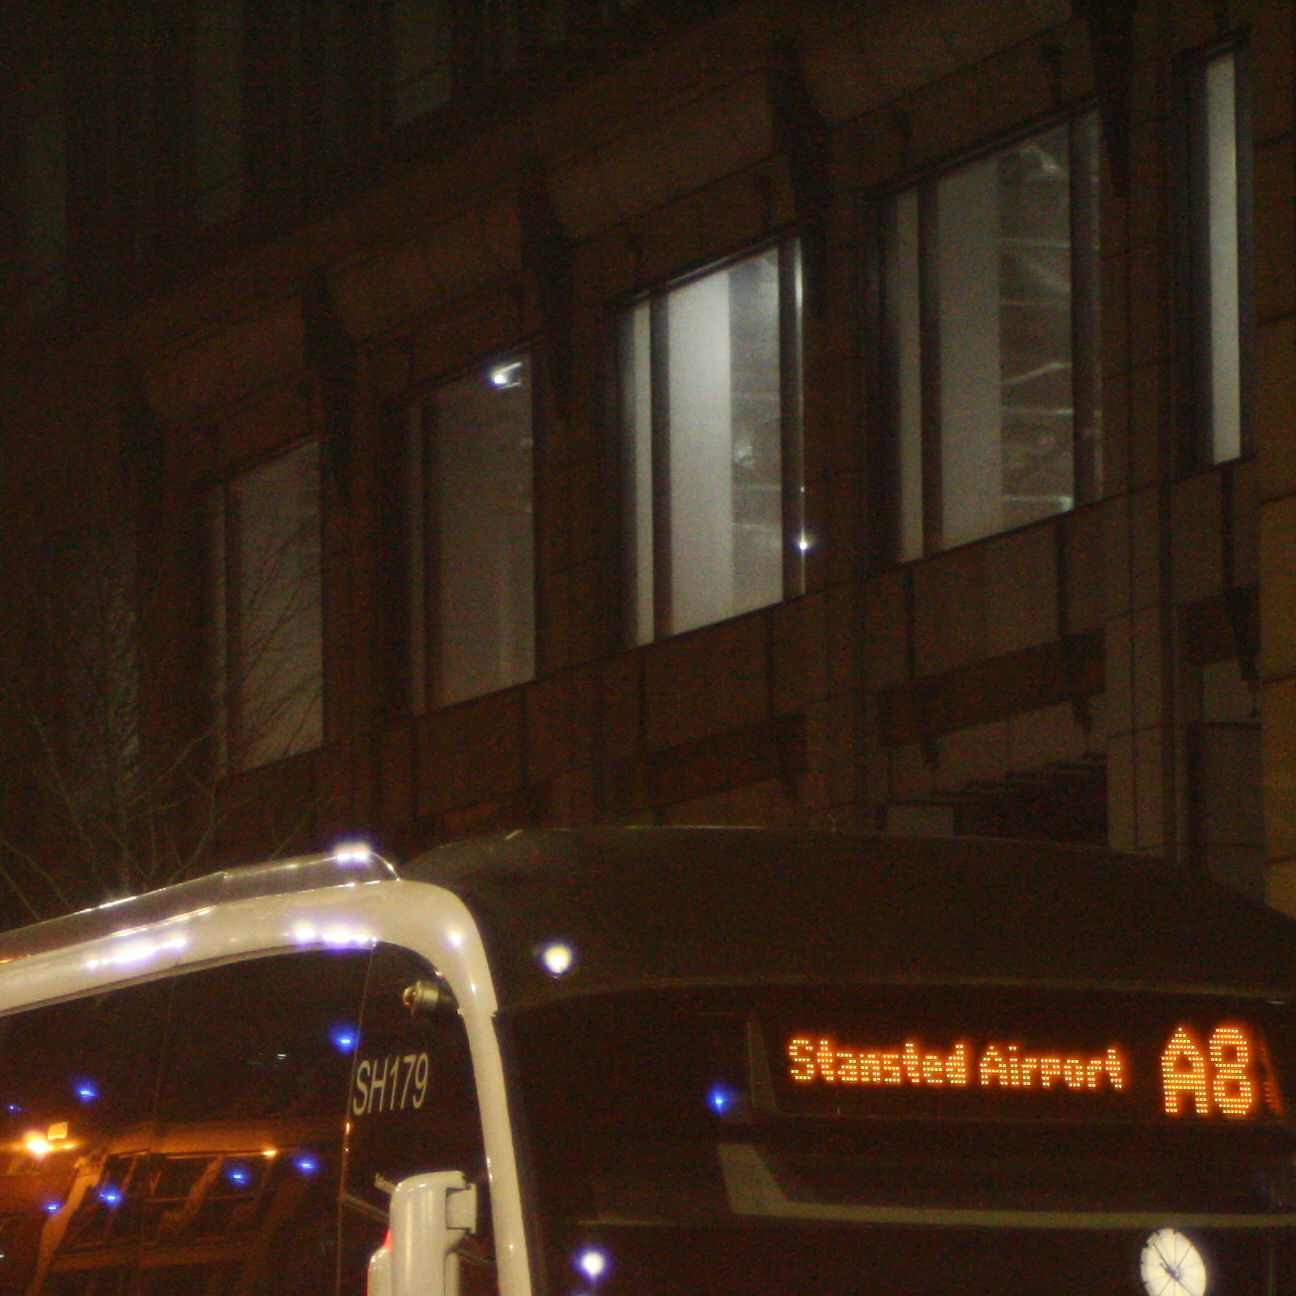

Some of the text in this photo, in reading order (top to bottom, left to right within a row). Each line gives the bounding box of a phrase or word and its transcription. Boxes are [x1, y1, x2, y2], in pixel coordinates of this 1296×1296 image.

[353, 1052, 430, 1116] SH179
[788, 1026, 1253, 1116] Stansted Airport A8
